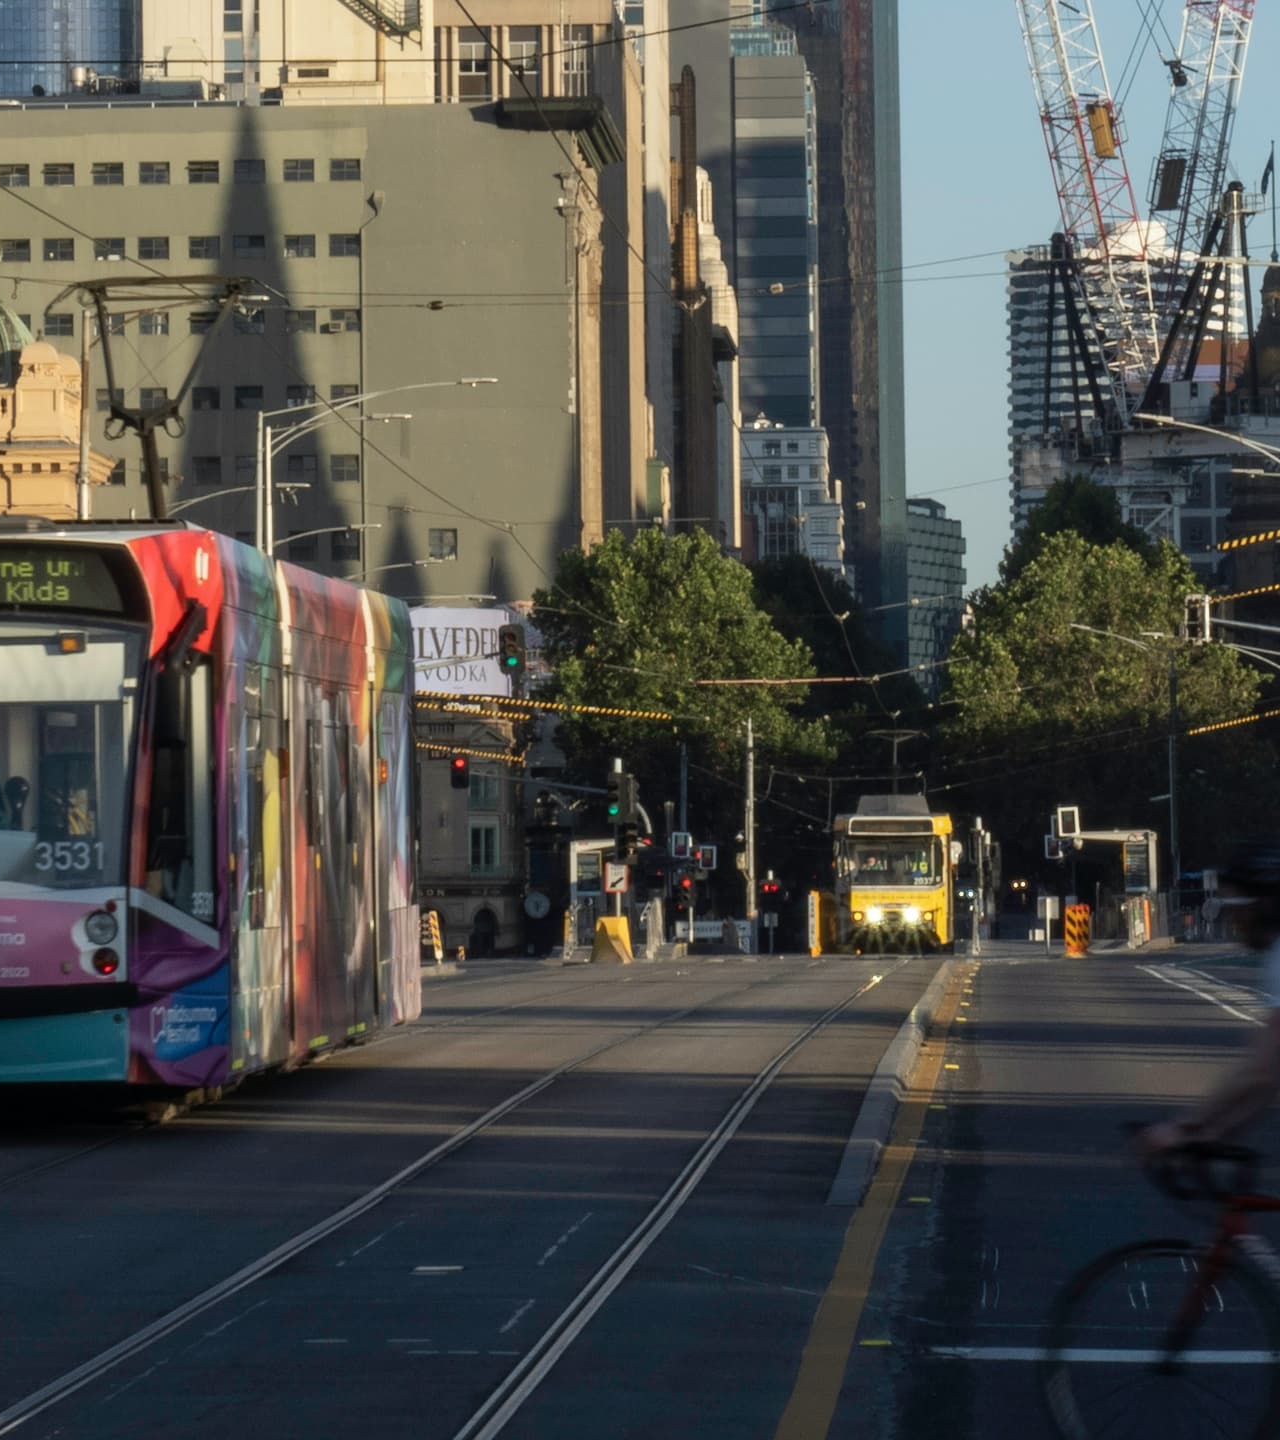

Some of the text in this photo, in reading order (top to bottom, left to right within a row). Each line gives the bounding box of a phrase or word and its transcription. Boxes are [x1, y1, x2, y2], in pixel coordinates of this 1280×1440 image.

[6, 581, 70, 602] Kilda
[422, 664, 487, 682] VODKA
[35, 842, 105, 871] 3531
